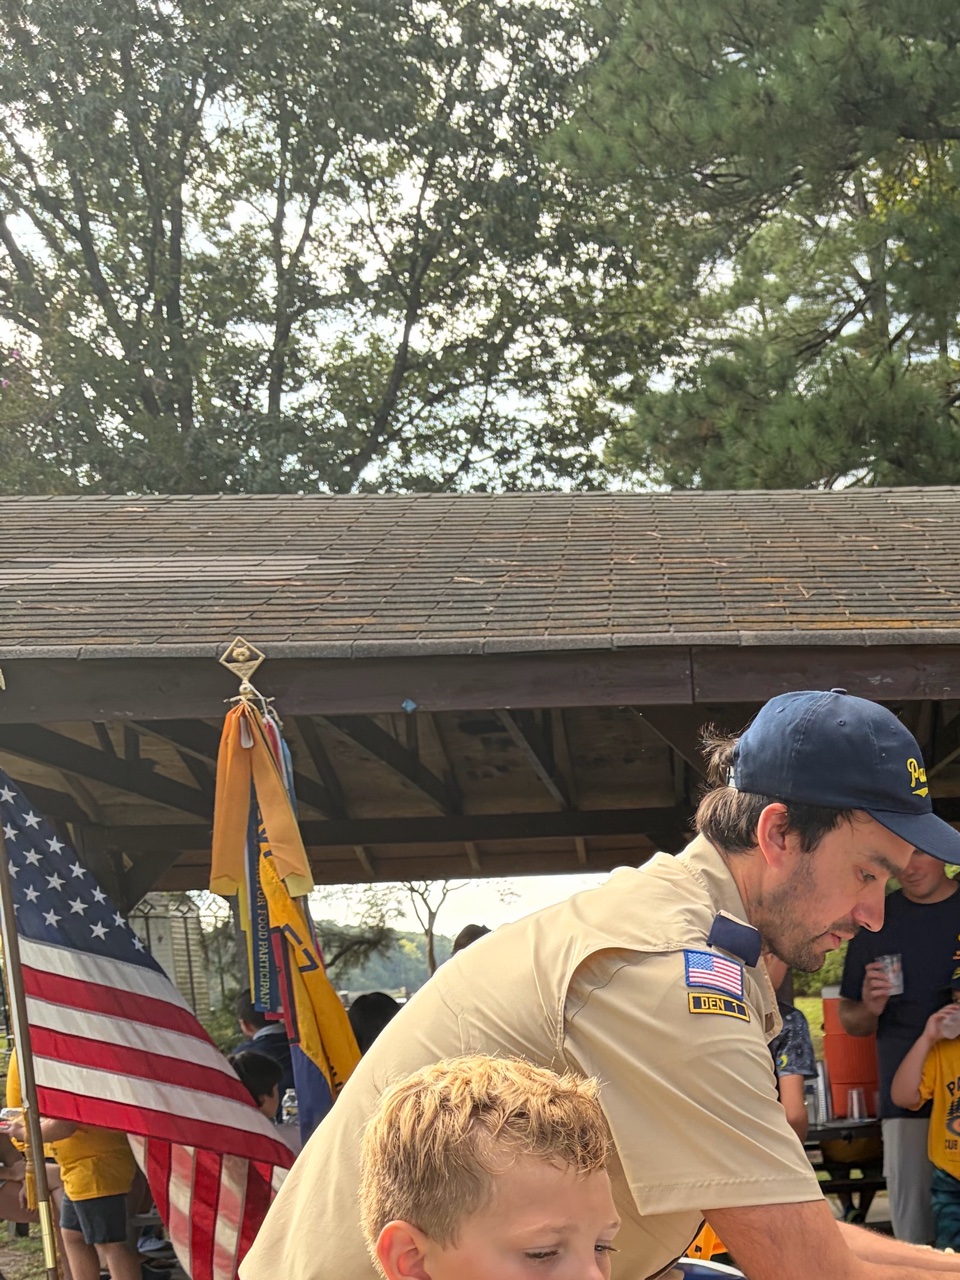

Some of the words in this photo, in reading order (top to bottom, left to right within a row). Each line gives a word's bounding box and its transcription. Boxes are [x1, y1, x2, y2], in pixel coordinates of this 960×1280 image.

[906, 758, 927, 787] Pa
[257, 909, 268, 939] FOOD
[258, 941, 271, 1009] PARTICIPANT
[701, 996, 724, 1011] DEN
[732, 1002, 738, 1014] 1
